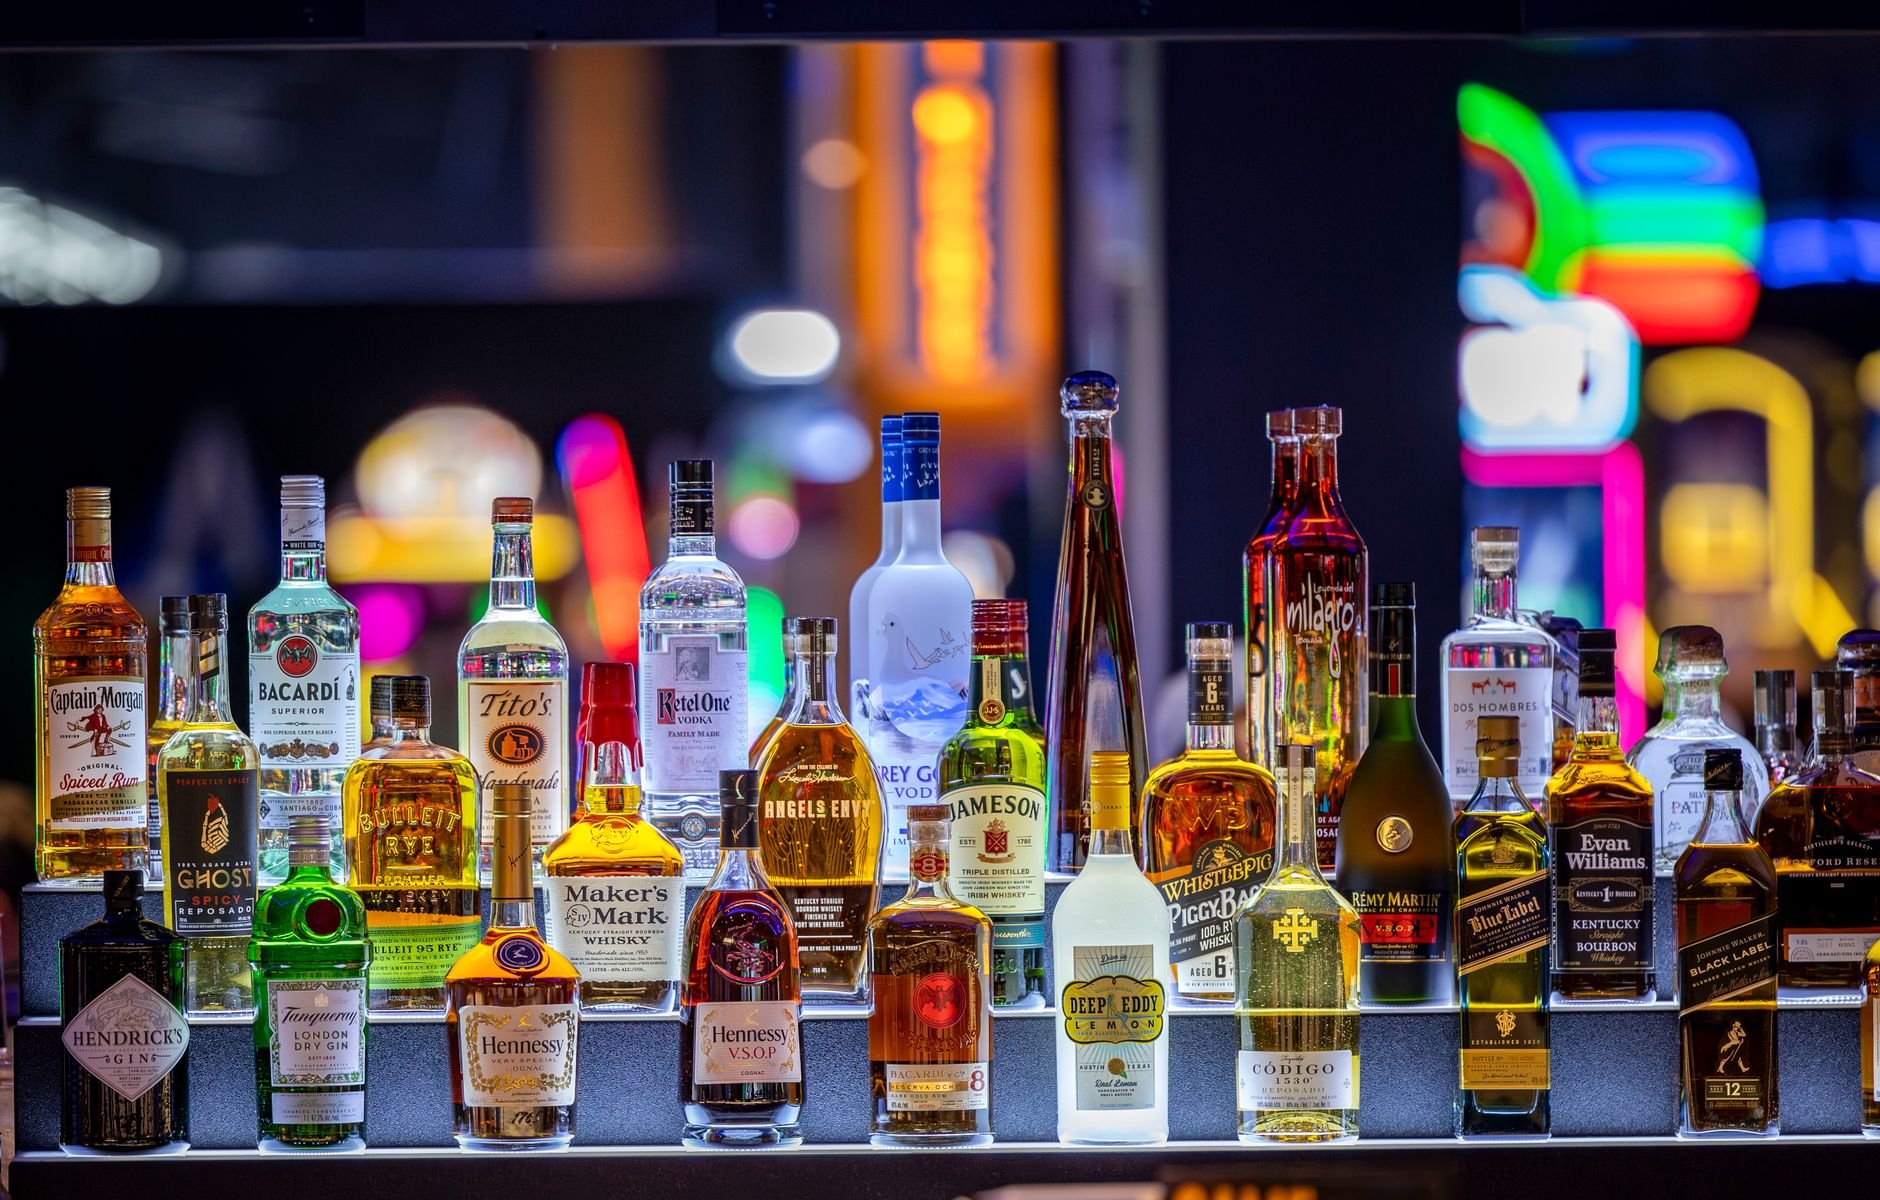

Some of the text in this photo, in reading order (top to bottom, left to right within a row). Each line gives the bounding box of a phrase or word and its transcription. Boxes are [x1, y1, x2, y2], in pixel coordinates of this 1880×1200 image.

[1313, 582, 1354, 597] Leyenda del
[1287, 571, 1354, 679] milagro
[1202, 675, 1222, 683] AGED
[259, 677, 340, 701] BACARDÍ
[1206, 682, 1218, 704] 6
[50, 685, 144, 715] Captain Morgan
[480, 689, 552, 717] Tito's
[657, 689, 730, 722] Ketel One
[1453, 702, 1537, 713] DOS HOMBRES
[271, 707, 326, 715] SUPERIOR
[1200, 704, 1225, 712] YEARS
[677, 716, 713, 725] VODKA
[697, 730, 720, 738] MADE
[81, 763, 119, 772] ORIGINAL
[878, 765, 913, 783] REY
[59, 771, 140, 792] Spiced Rum
[176, 777, 224, 786] PERFECTLY
[279, 804, 317, 812] SANTIAGO
[765, 800, 871, 819] ANGELS ENVY
[950, 795, 1041, 822] JAMESON
[358, 806, 462, 834] BULLEIT
[385, 836, 435, 857] RYE
[1580, 833, 1631, 852] Evan
[922, 857, 937, 873] 8
[1565, 852, 1646, 870] Williams
[177, 868, 252, 889] GHOST
[961, 868, 1030, 876] TRIPLE DISTILLED
[1162, 853, 1273, 903] WHISTLEPIG
[375, 874, 445, 887] FRONTIER
[191, 895, 241, 906] SPICY
[564, 884, 669, 903] Maker's
[794, 897, 819, 905] KENTUCKY
[990, 891, 1026, 899] WHISKEY
[1352, 891, 1439, 907] RÉMY MARTIN
[796, 905, 820, 913] BOURBON
[1166, 884, 1265, 934] PIGGYBAC
[1474, 889, 1530, 915] JOHNNIE WALKER
[178, 905, 252, 916] REPOSADO
[571, 908, 577, 916] S
[578, 914, 588, 922] IV
[592, 907, 668, 925] Mark
[1467, 912, 1504, 936] Blue
[1500, 896, 1541, 924] Label
[1572, 919, 1641, 929] KENTUCKY
[583, 936, 652, 945] WHISKY
[1589, 930, 1624, 942] Straight
[373, 943, 458, 954] ULLEIT 95 RYE
[1576, 942, 1637, 952] BOURBON
[1696, 932, 1764, 963] JOHNNIE WALKER
[1590, 952, 1625, 965] Whiskey
[1689, 941, 1771, 977] BLACK LABEL
[1190, 955, 1227, 978] AGED 6
[1692, 974, 1720, 988] BLENDED
[1722, 964, 1746, 978] SCOTCH
[1070, 995, 1158, 1014] DEEP EDDY
[281, 1006, 358, 1027] Tanqueray
[1075, 1019, 1155, 1030] LEMON
[73, 1028, 183, 1047] HENDRICK'S
[294, 1030, 349, 1040] LONDON
[712, 1025, 789, 1046] Hennessy
[294, 1041, 349, 1051] DRY GIN
[482, 1035, 565, 1056] Hennessy
[729, 1046, 777, 1060] V.S.O.P
[114, 1053, 149, 1065] GIN
[1252, 1061, 1335, 1076] CÓDIGO
[1113, 1079, 1137, 1088] Lemon
[1275, 1077, 1310, 1085] 1530
[1262, 1086, 1326, 1094] REPOSADO
[1725, 1082, 1741, 1096] 12
